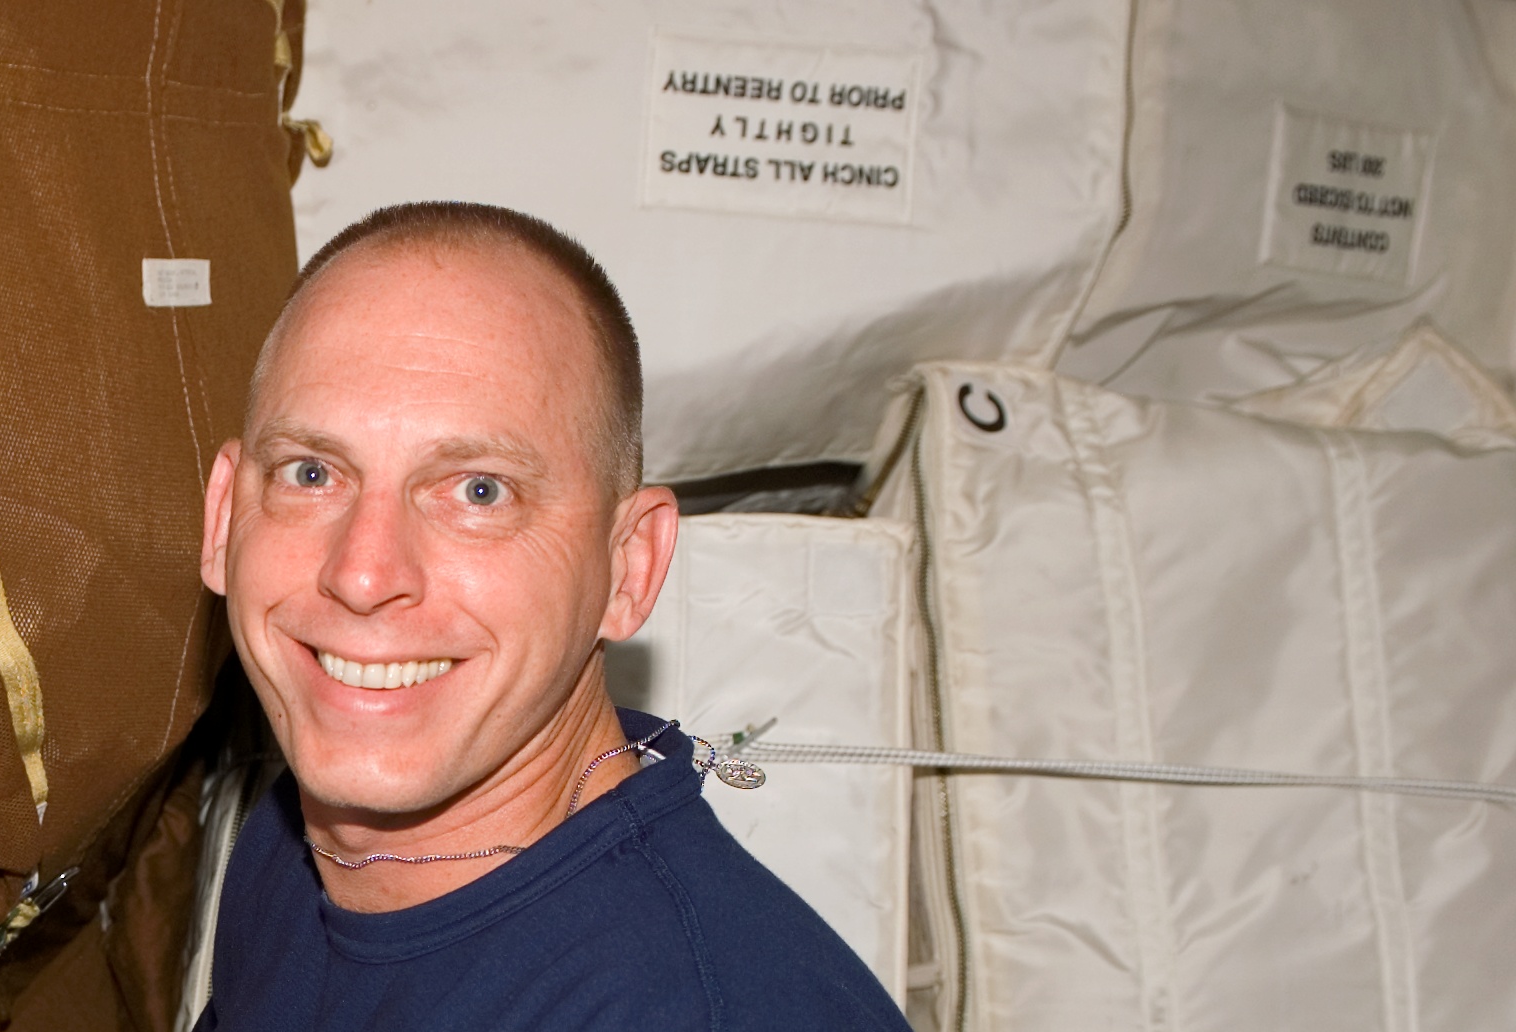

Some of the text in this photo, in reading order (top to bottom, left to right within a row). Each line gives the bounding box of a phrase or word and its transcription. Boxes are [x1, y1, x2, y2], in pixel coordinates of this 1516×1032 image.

[662, 70, 906, 110] PRIOR TO REENTRY
[710, 114, 854, 146] TIGHTLY
[660, 150, 900, 187] CINCH ALL STRAPS
[1310, 222, 1390, 254] CONTENTS
[958, 382, 1007, 433] C
